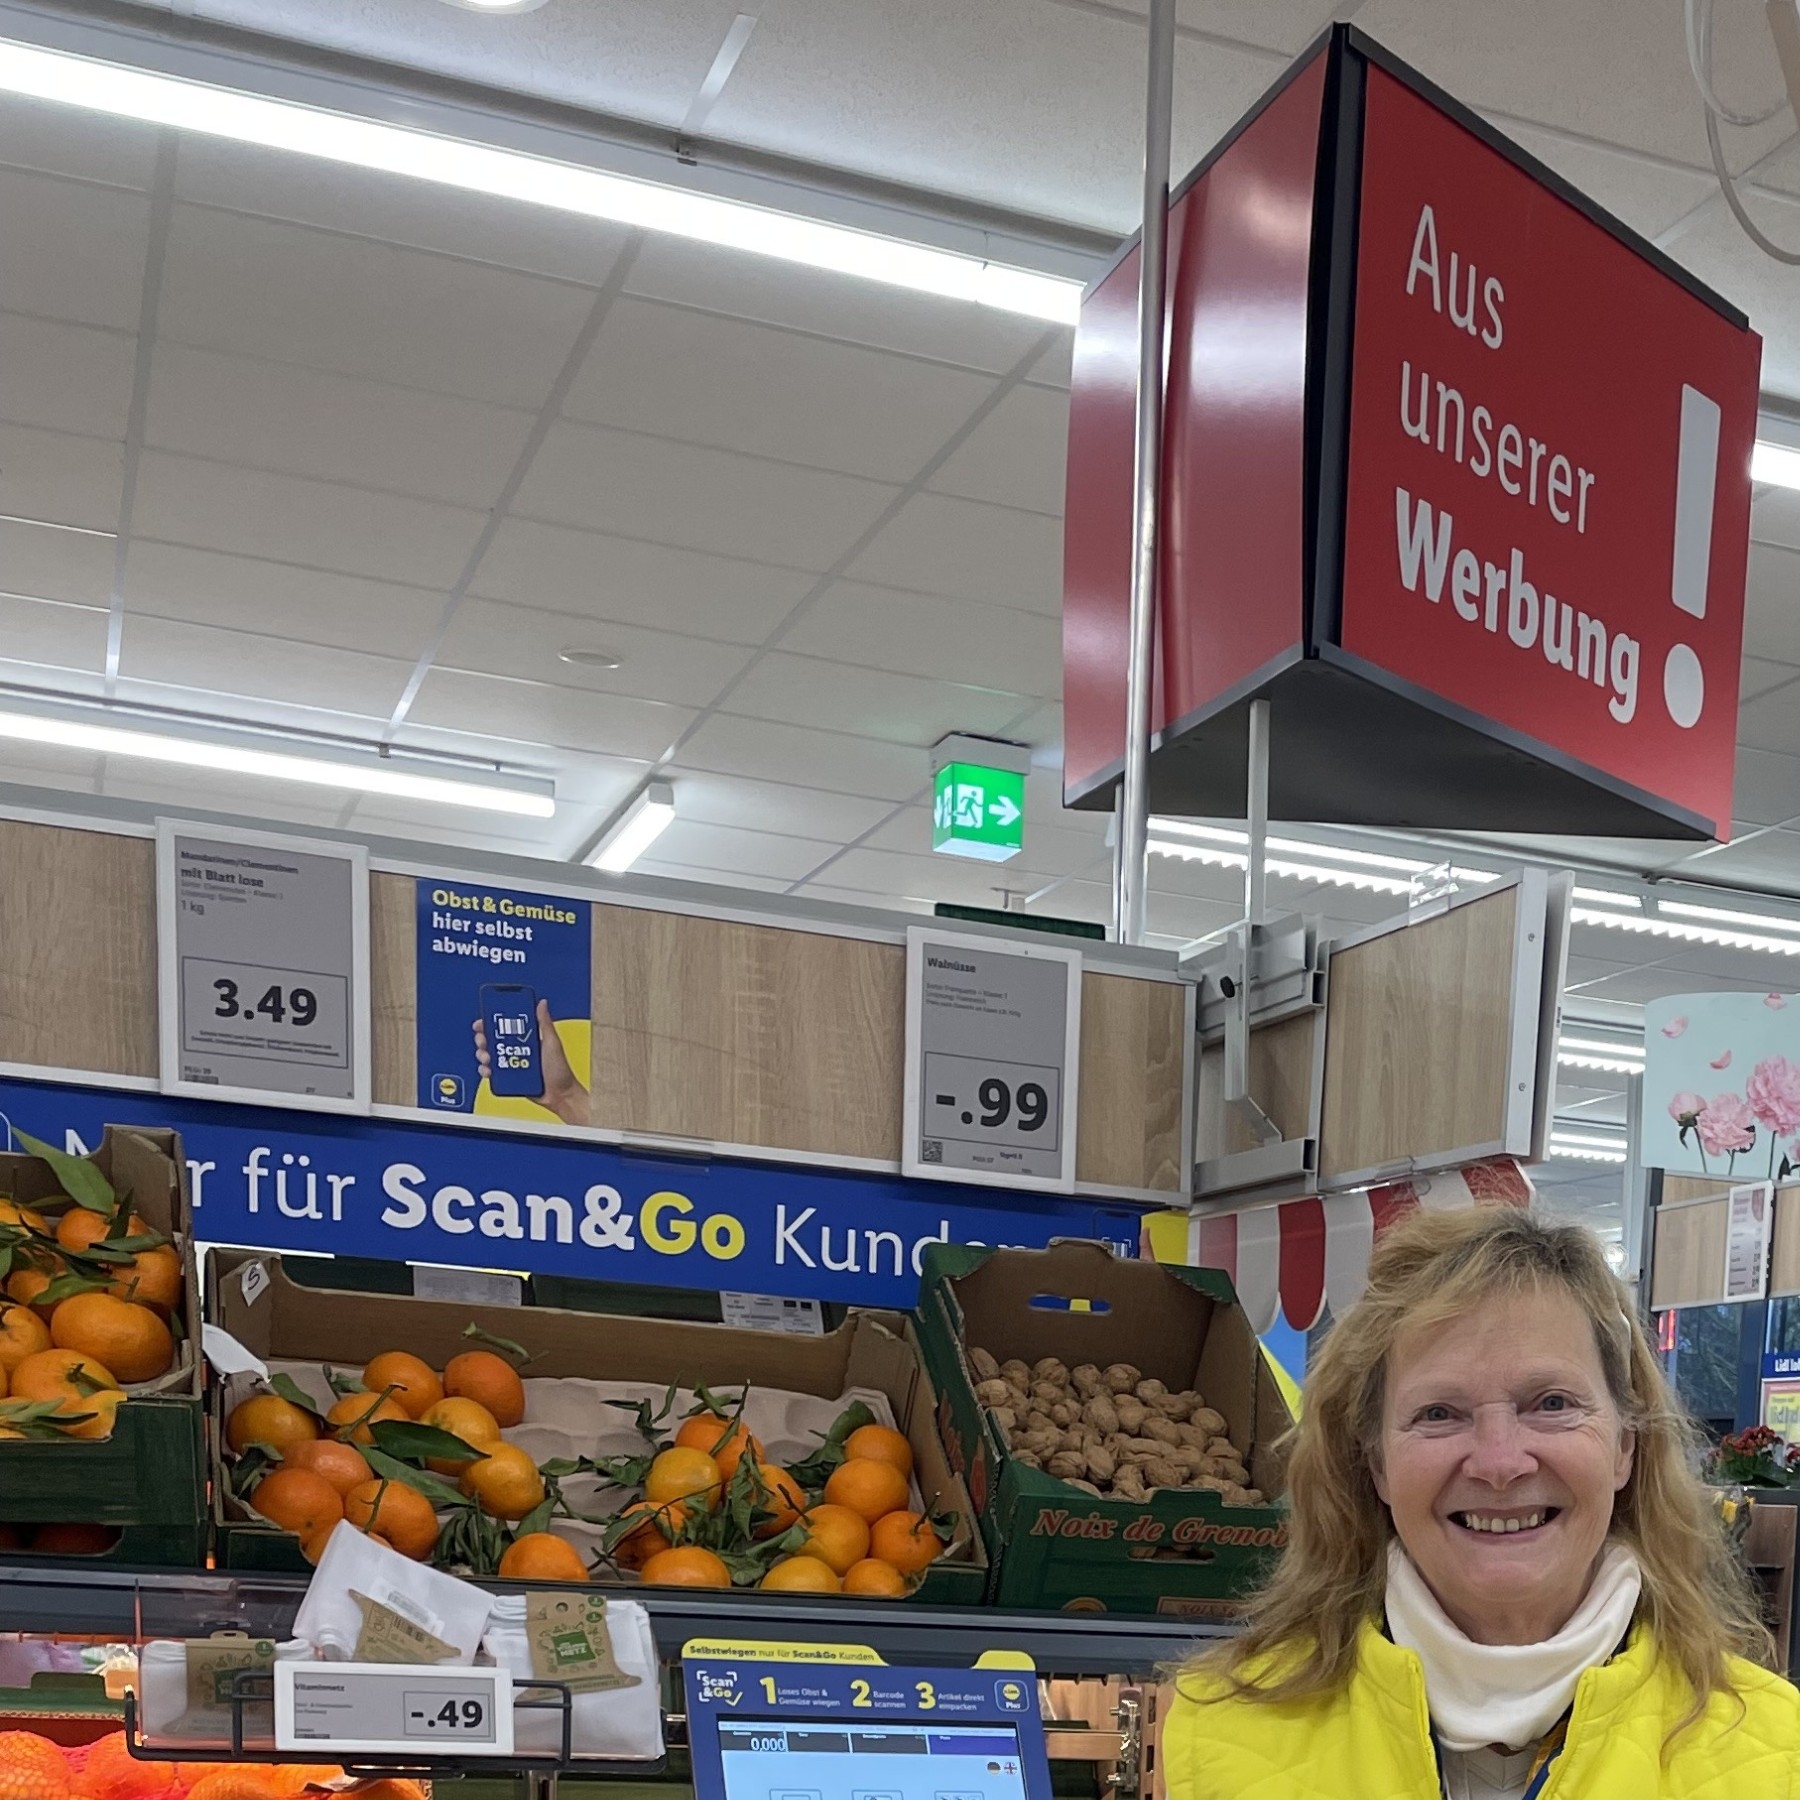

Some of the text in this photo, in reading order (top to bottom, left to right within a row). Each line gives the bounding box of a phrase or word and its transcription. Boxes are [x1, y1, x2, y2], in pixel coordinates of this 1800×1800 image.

[1406, 204, 1504, 349] Aus
[1400, 361, 1595, 533] unserer
[1396, 487, 1639, 723] Werbung
[181, 868, 264, 888] mit Blatt lose
[190, 901, 205, 916] kg
[432, 890, 577, 924] Obst & Gemüse
[432, 912, 533, 942] hier selbst
[432, 937, 526, 964] abwiegen
[927, 957, 976, 973] Walnüsse
[213, 978, 317, 1027] 3.49
[496, 1043, 531, 1057] Scan
[497, 1056, 530, 1069] &Go
[935, 1078, 1049, 1132] -.99
[242, 1146, 356, 1222] für
[381, 1162, 746, 1261] Scan&Go
[774, 1203, 1027, 1277] Kund
[1030, 1509, 1118, 1540] Noix
[1123, 1514, 1166, 1543] de
[689, 1645, 875, 1661] Selbstwiegen nur für Scan&Go Kunden
[702, 1675, 735, 1688] Scan
[703, 1687, 732, 1698] &Go
[759, 1676, 828, 1705] 1 Loses Obst &
[850, 1678, 905, 1708] 2 Barcode
[914, 1681, 985, 1710] 3 Artikel direkt
[411, 1700, 484, 1729] -.49
[778, 1696, 841, 1708] Gemüse wiegen
[874, 1700, 906, 1709] scannen
